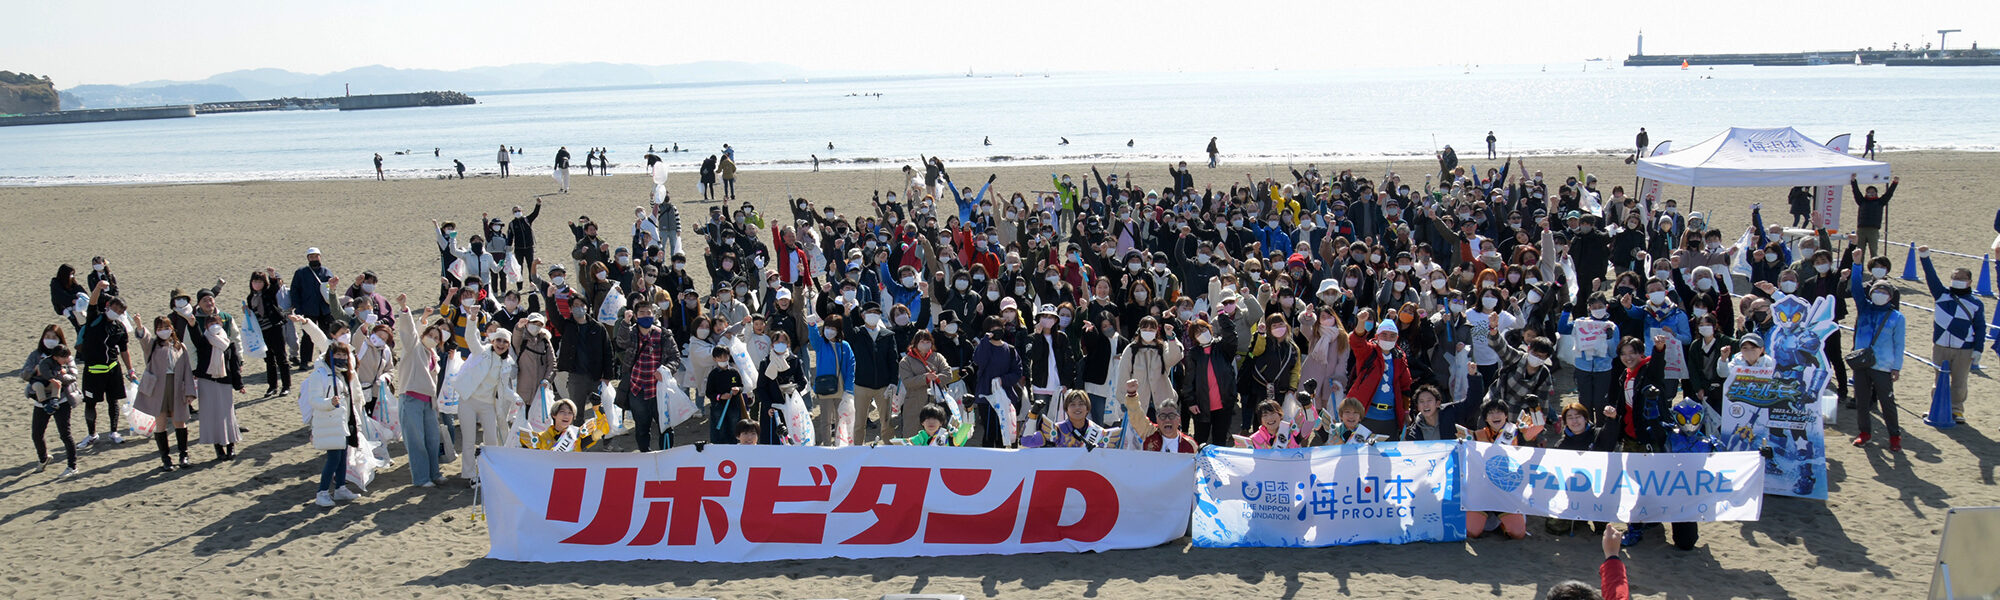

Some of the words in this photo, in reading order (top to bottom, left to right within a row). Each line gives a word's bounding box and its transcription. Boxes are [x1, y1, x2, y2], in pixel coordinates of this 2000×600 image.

[1264, 481, 1290, 492] 日本
[1528, 464, 1602, 494] PADI
[1610, 469, 1737, 496] AWARE
[545, 459, 1120, 545] リポビタンD
[1295, 473, 1416, 521] 海と日本
[1259, 504, 1290, 513] NIPPON
[1342, 506, 1416, 520] PROJECT
[1241, 511, 1290, 521] FOUNDATION
